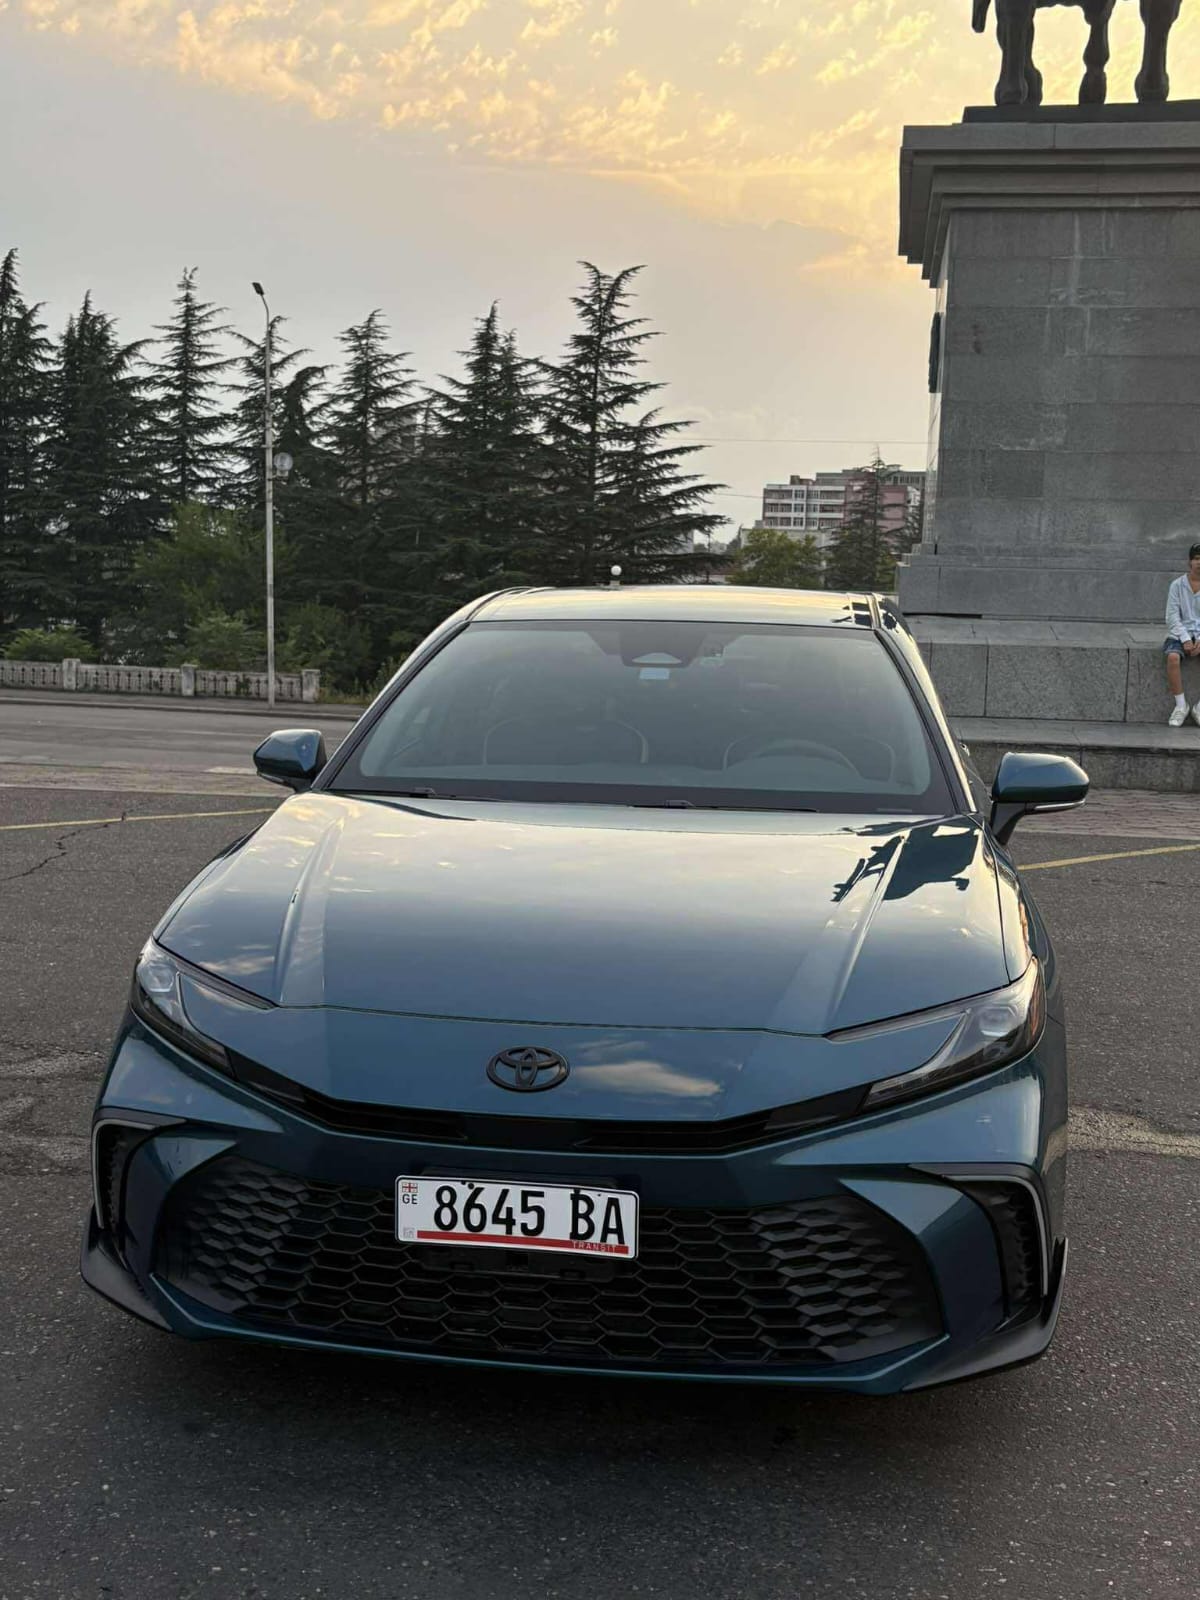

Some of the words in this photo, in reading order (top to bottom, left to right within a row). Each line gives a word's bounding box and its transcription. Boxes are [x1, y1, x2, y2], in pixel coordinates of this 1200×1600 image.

[402, 1193, 418, 1205] GE
[434, 1185, 545, 1237] 8645
[569, 1192, 625, 1245] BA
[572, 1240, 616, 1252] TRANSIT
